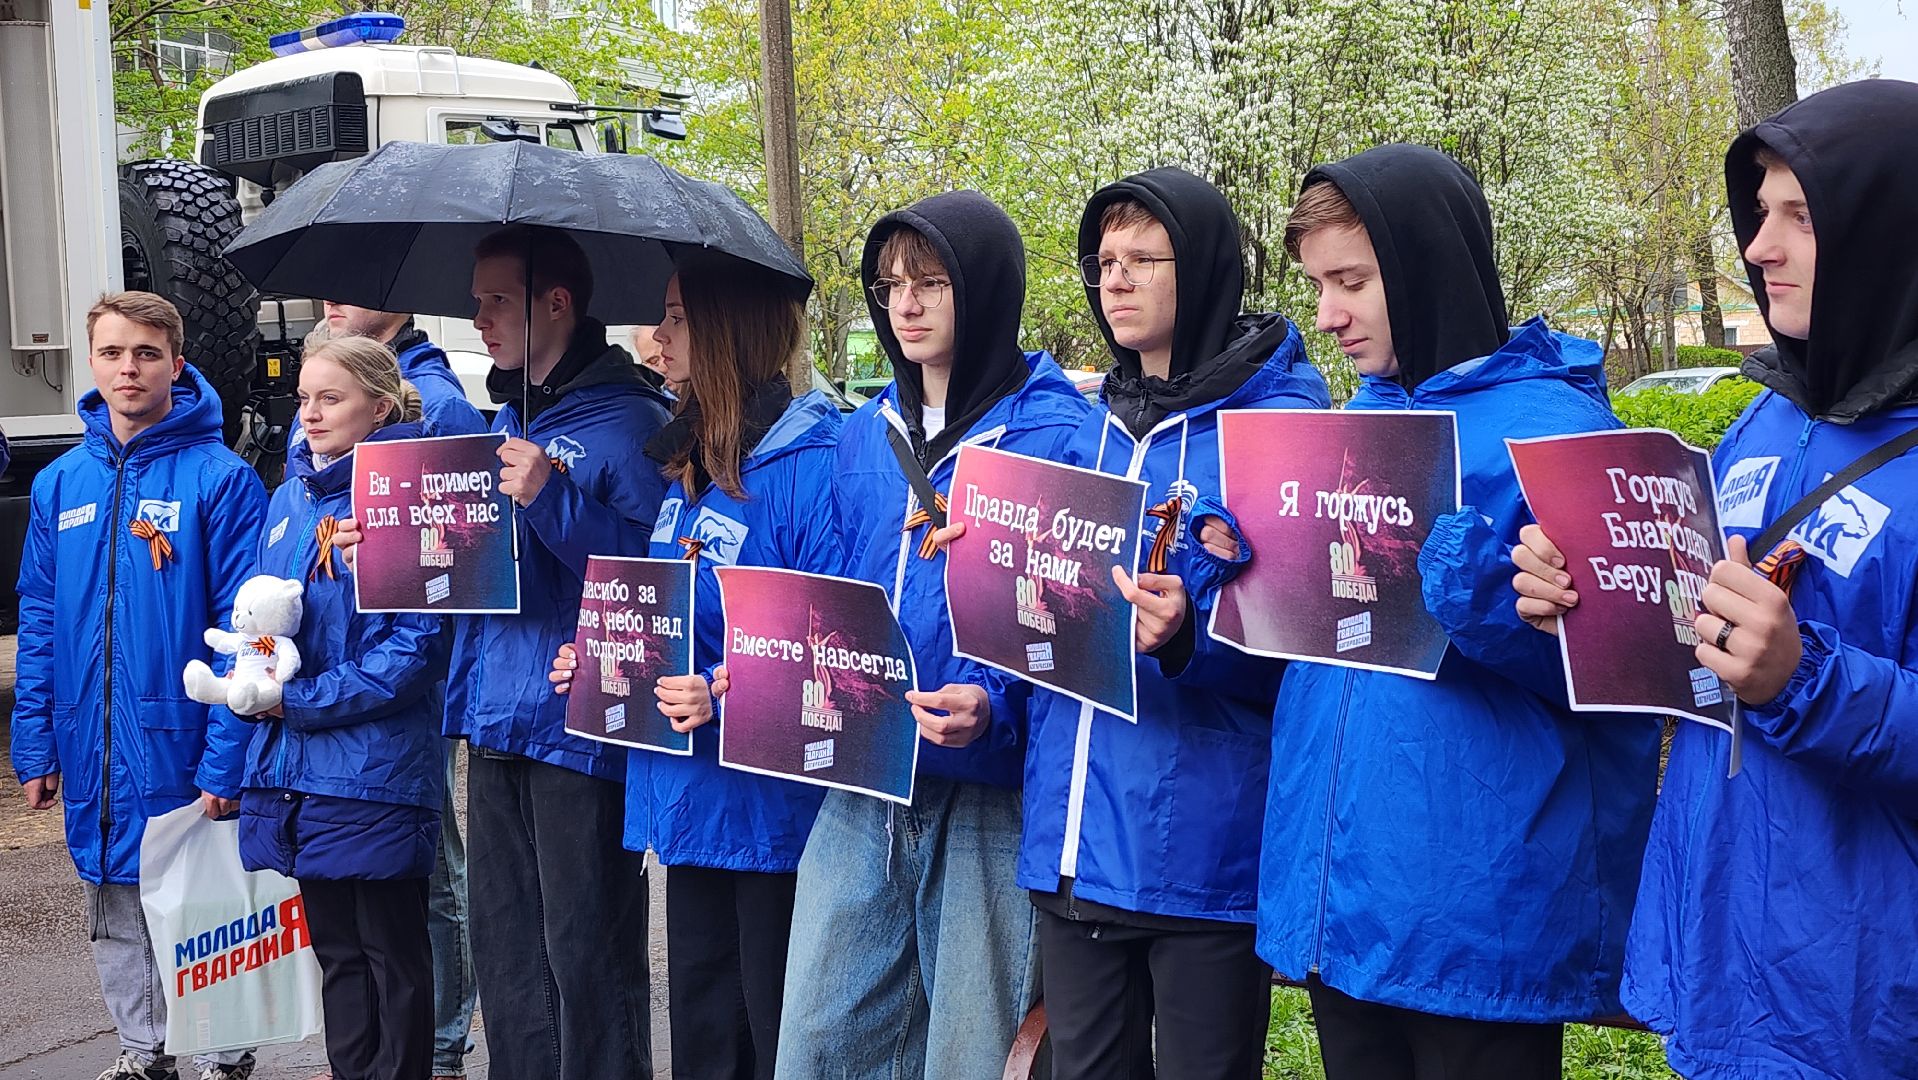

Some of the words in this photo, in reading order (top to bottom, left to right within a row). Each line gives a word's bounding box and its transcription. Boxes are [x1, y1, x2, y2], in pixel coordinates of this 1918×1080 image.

[368, 472, 390, 495] Вы
[422, 471, 492, 500] пример
[366, 507, 400, 529] для
[409, 504, 456, 526] всех
[466, 503, 499, 523] нас
[964, 484, 1040, 533] Правда
[1052, 507, 1126, 555] будет
[1279, 480, 1300, 517] Я
[1315, 490, 1414, 534] горжусь
[420, 527, 439, 552] 80
[420, 553, 454, 568] ПОБЕДА!
[989, 540, 1014, 569] за
[1025, 546, 1082, 587] нами
[1330, 541, 1355, 576] 80
[638, 585, 657, 604] за
[1016, 575, 1037, 609] 80
[1332, 580, 1378, 603] ПОБЕДА!
[1588, 556, 1661, 604] Беру
[1665, 579, 1696, 619] 80
[606, 608, 644, 632] небо
[652, 615, 683, 639] над
[1017, 610, 1057, 635] ПОБЕДА!
[586, 638, 645, 663] головой
[732, 627, 803, 662] Вместе
[813, 645, 908, 681] навсегда
[601, 680, 631, 697] ПОБЕДА!
[802, 679, 825, 708] 80
[801, 711, 843, 732] ПОБЕДА!
